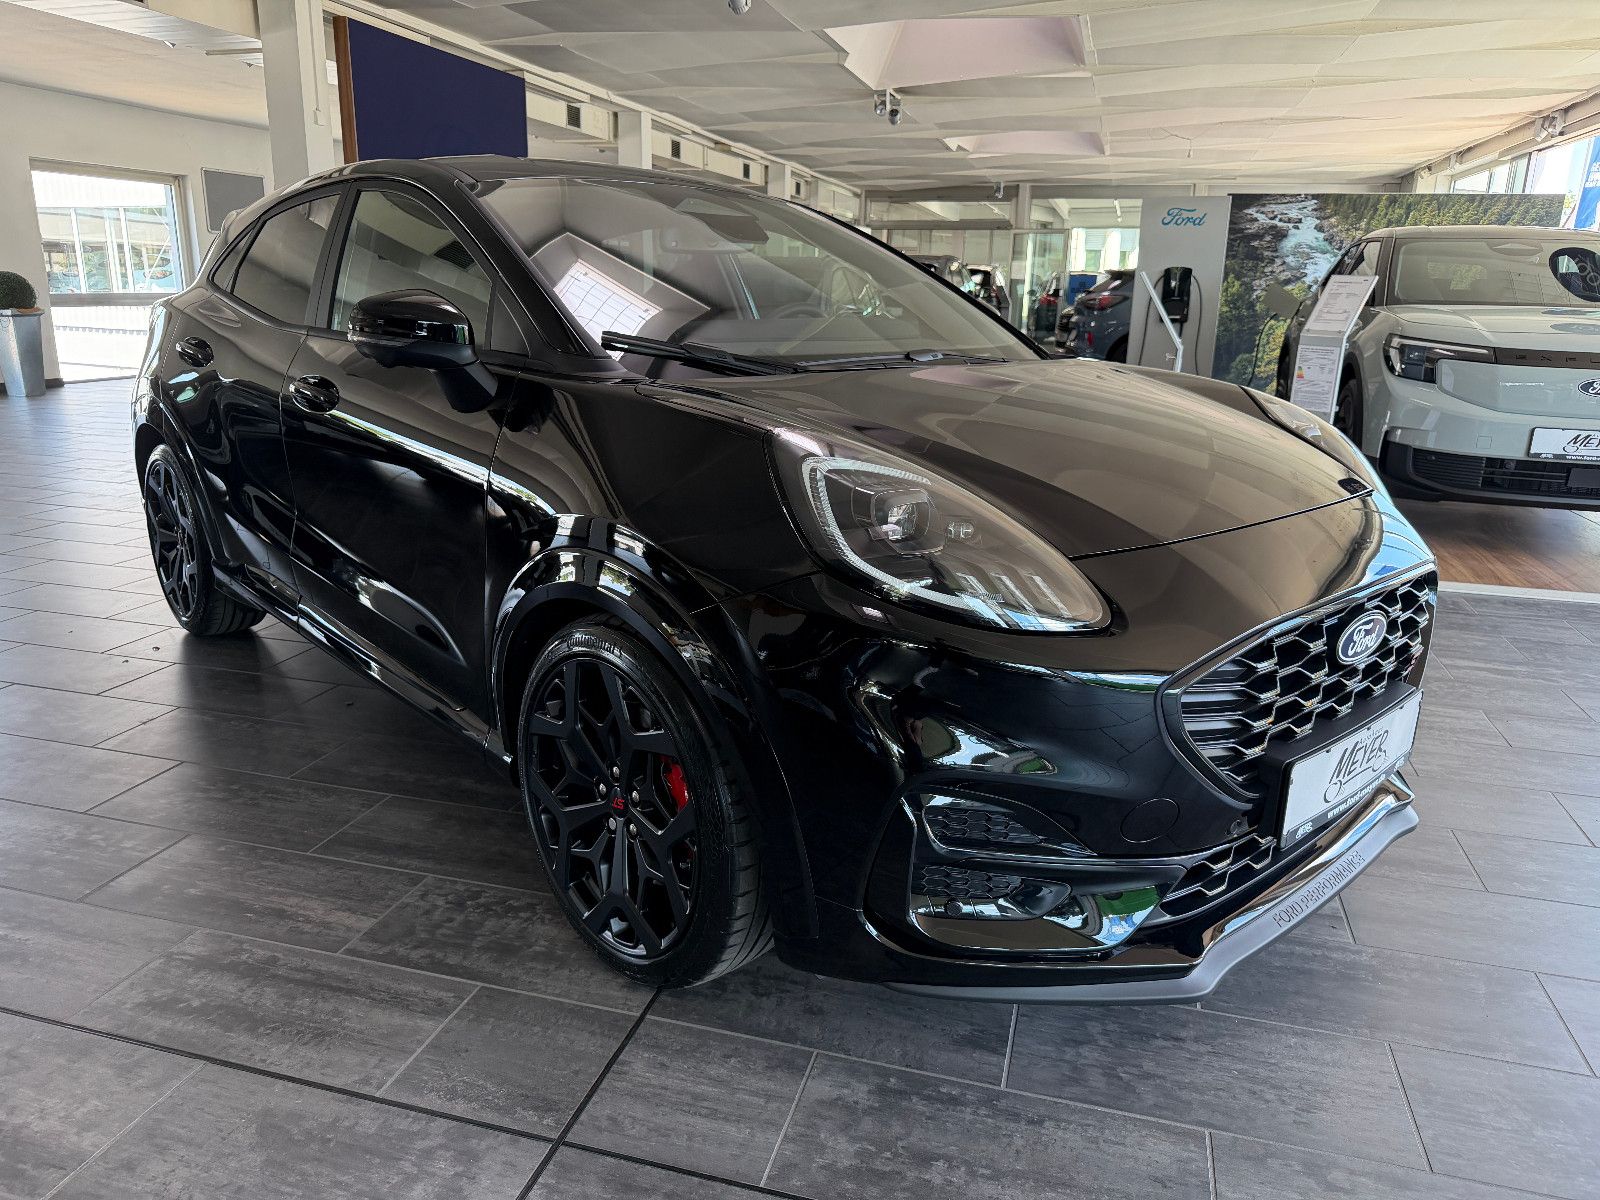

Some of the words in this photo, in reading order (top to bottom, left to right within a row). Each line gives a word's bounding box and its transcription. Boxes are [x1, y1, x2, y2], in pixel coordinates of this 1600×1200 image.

[1161, 207, 1207, 226] Ford
[1347, 621, 1380, 657] Ford
[1325, 729, 1390, 793] MEYER
[1272, 900, 1304, 928] FORD
[1300, 850, 1366, 909] PERFORMANCE
